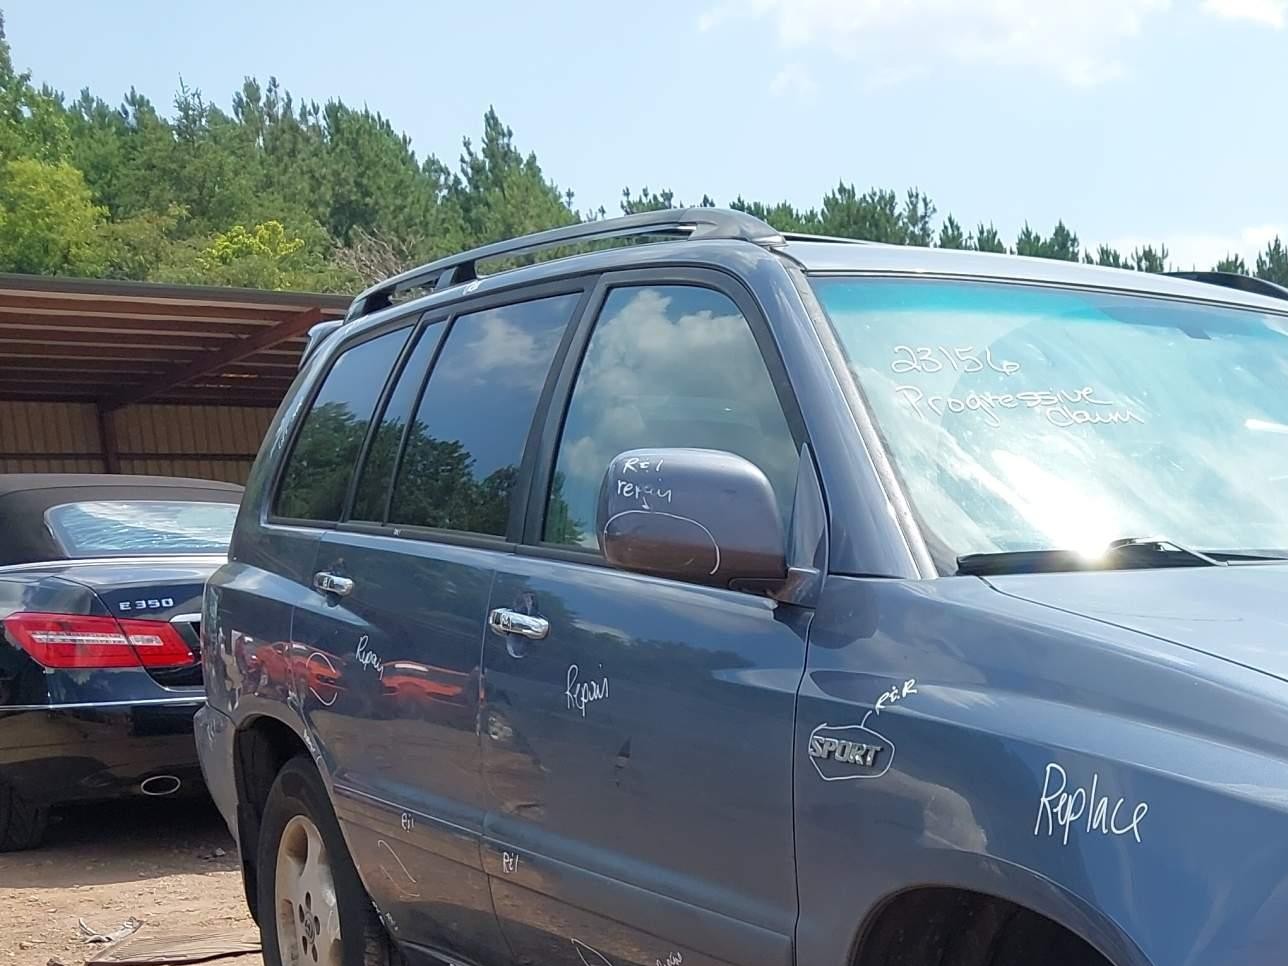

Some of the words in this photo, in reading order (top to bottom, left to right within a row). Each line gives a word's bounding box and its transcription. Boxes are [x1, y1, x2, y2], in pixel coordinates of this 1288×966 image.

[891, 345, 1021, 376] 23156
[895, 385, 1112, 428] Progressive
[119, 601, 131, 610] E
[135, 598, 174, 609] 350
[565, 663, 609, 717] Repair
[808, 735, 882, 766] SPORT
[1034, 762, 1149, 846] Replace
